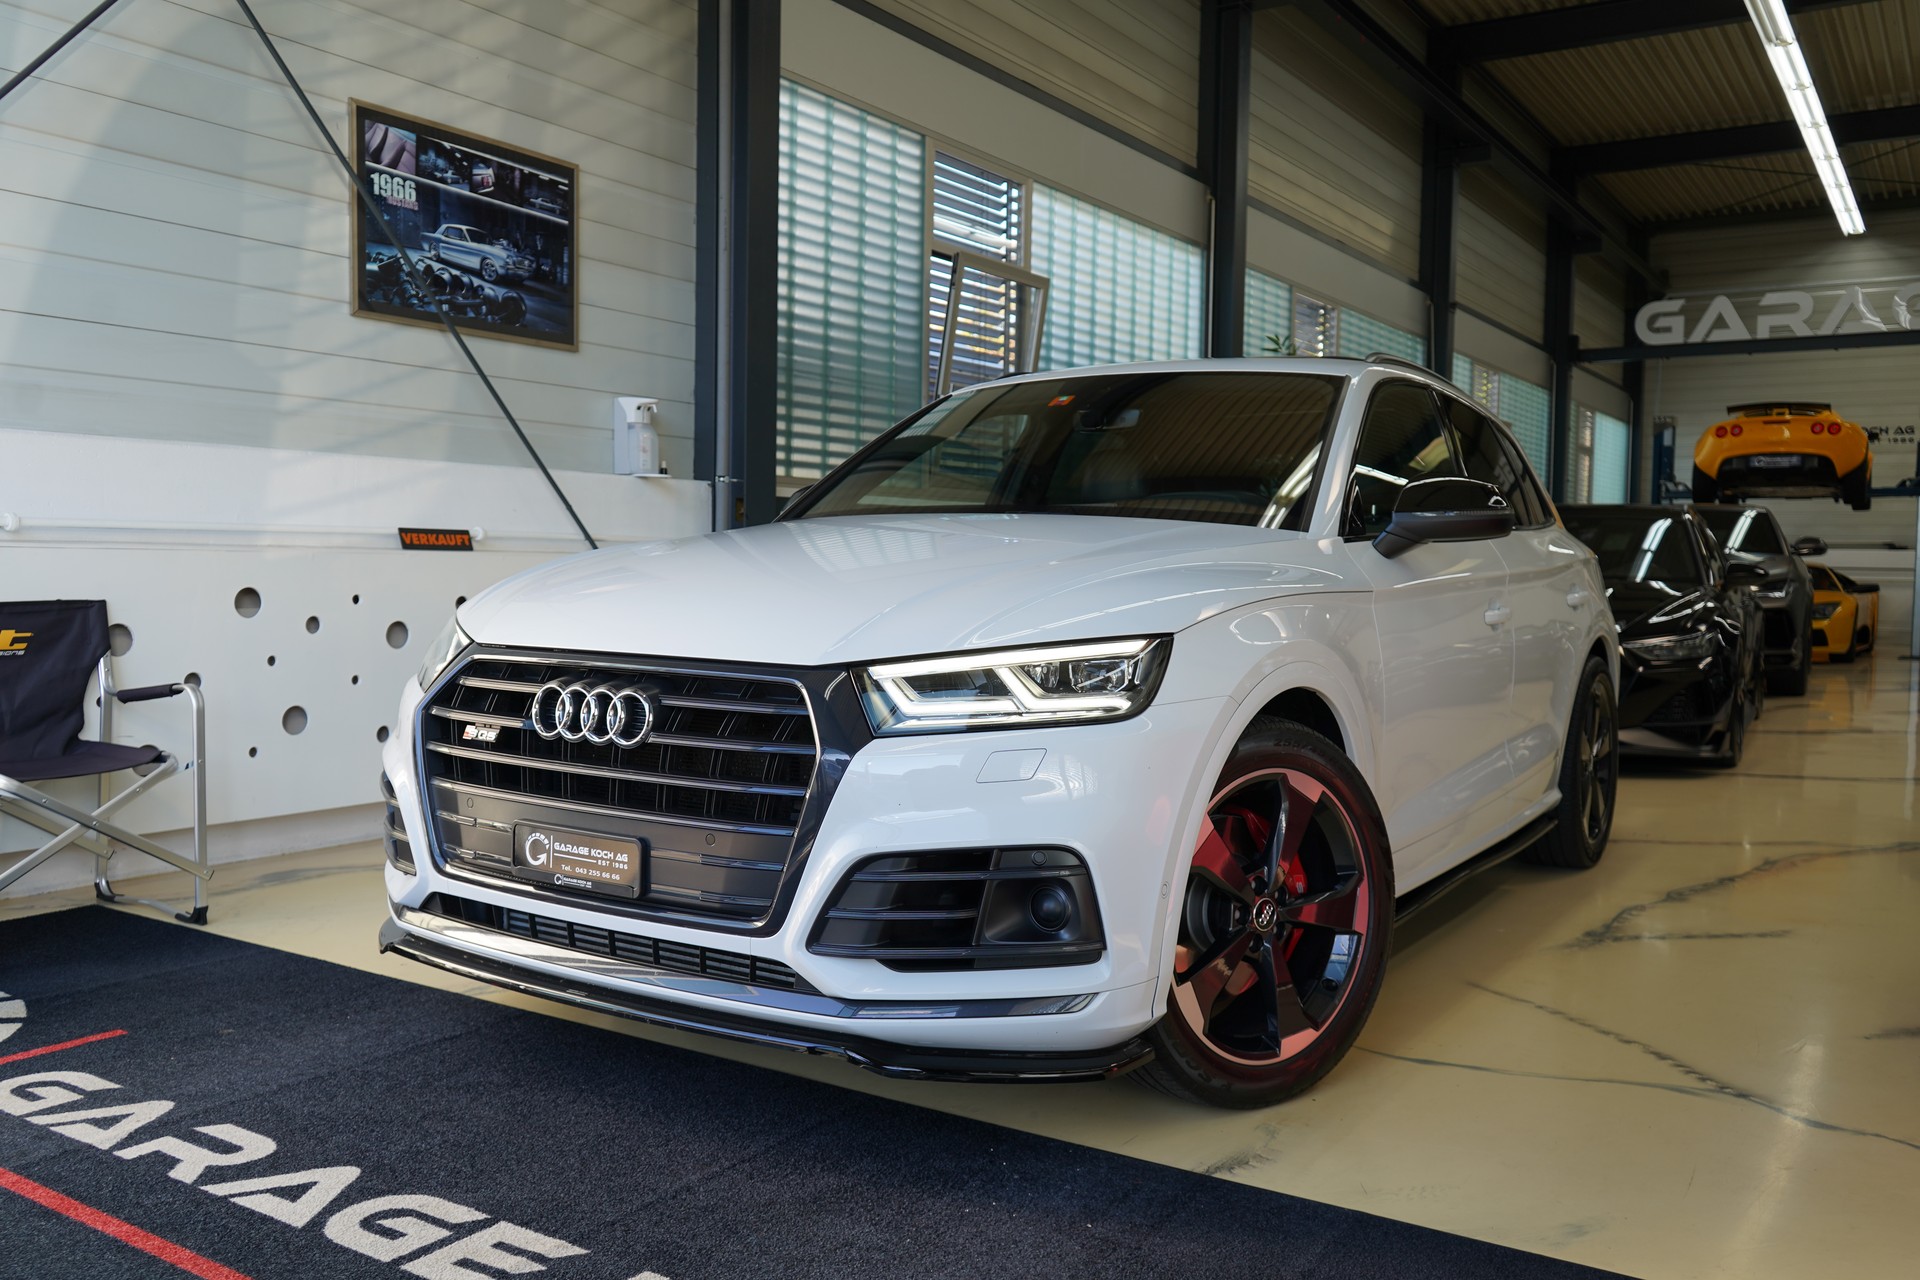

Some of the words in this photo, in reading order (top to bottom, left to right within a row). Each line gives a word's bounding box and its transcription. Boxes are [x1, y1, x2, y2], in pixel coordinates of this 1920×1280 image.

[370, 172, 417, 202] 1966
[1893, 425, 1915, 435] AG
[401, 532, 470, 546] VERKAUFT
[554, 842, 589, 855] GARAGE
[591, 848, 614, 859] KOCH
[615, 853, 628, 862] AG
[561, 864, 572, 872] Tel.
[0, 1070, 592, 1280] GARAGE
